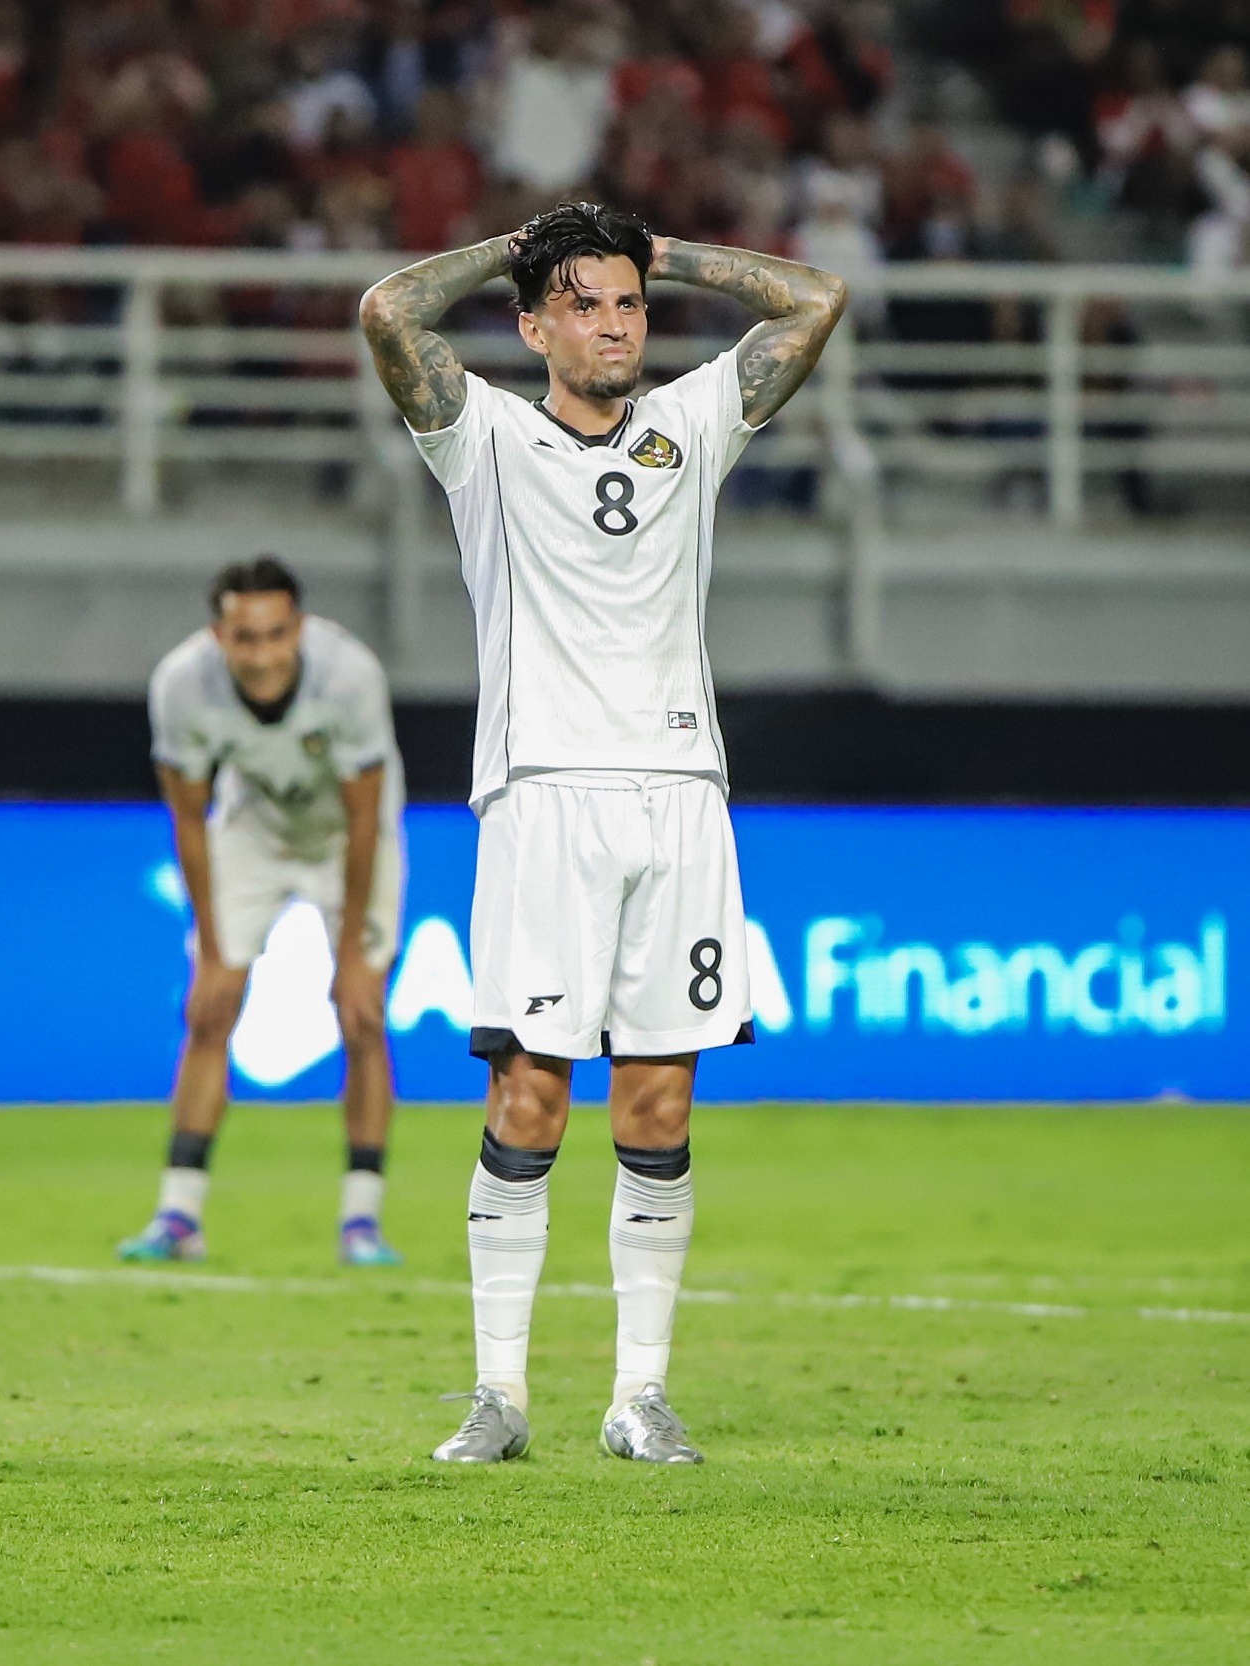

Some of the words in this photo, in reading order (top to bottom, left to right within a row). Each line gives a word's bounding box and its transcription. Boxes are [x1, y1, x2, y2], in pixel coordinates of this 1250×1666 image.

[593, 471, 638, 536] 8
[688, 937, 723, 1012] 8
[805, 911, 1227, 1037] Financial
